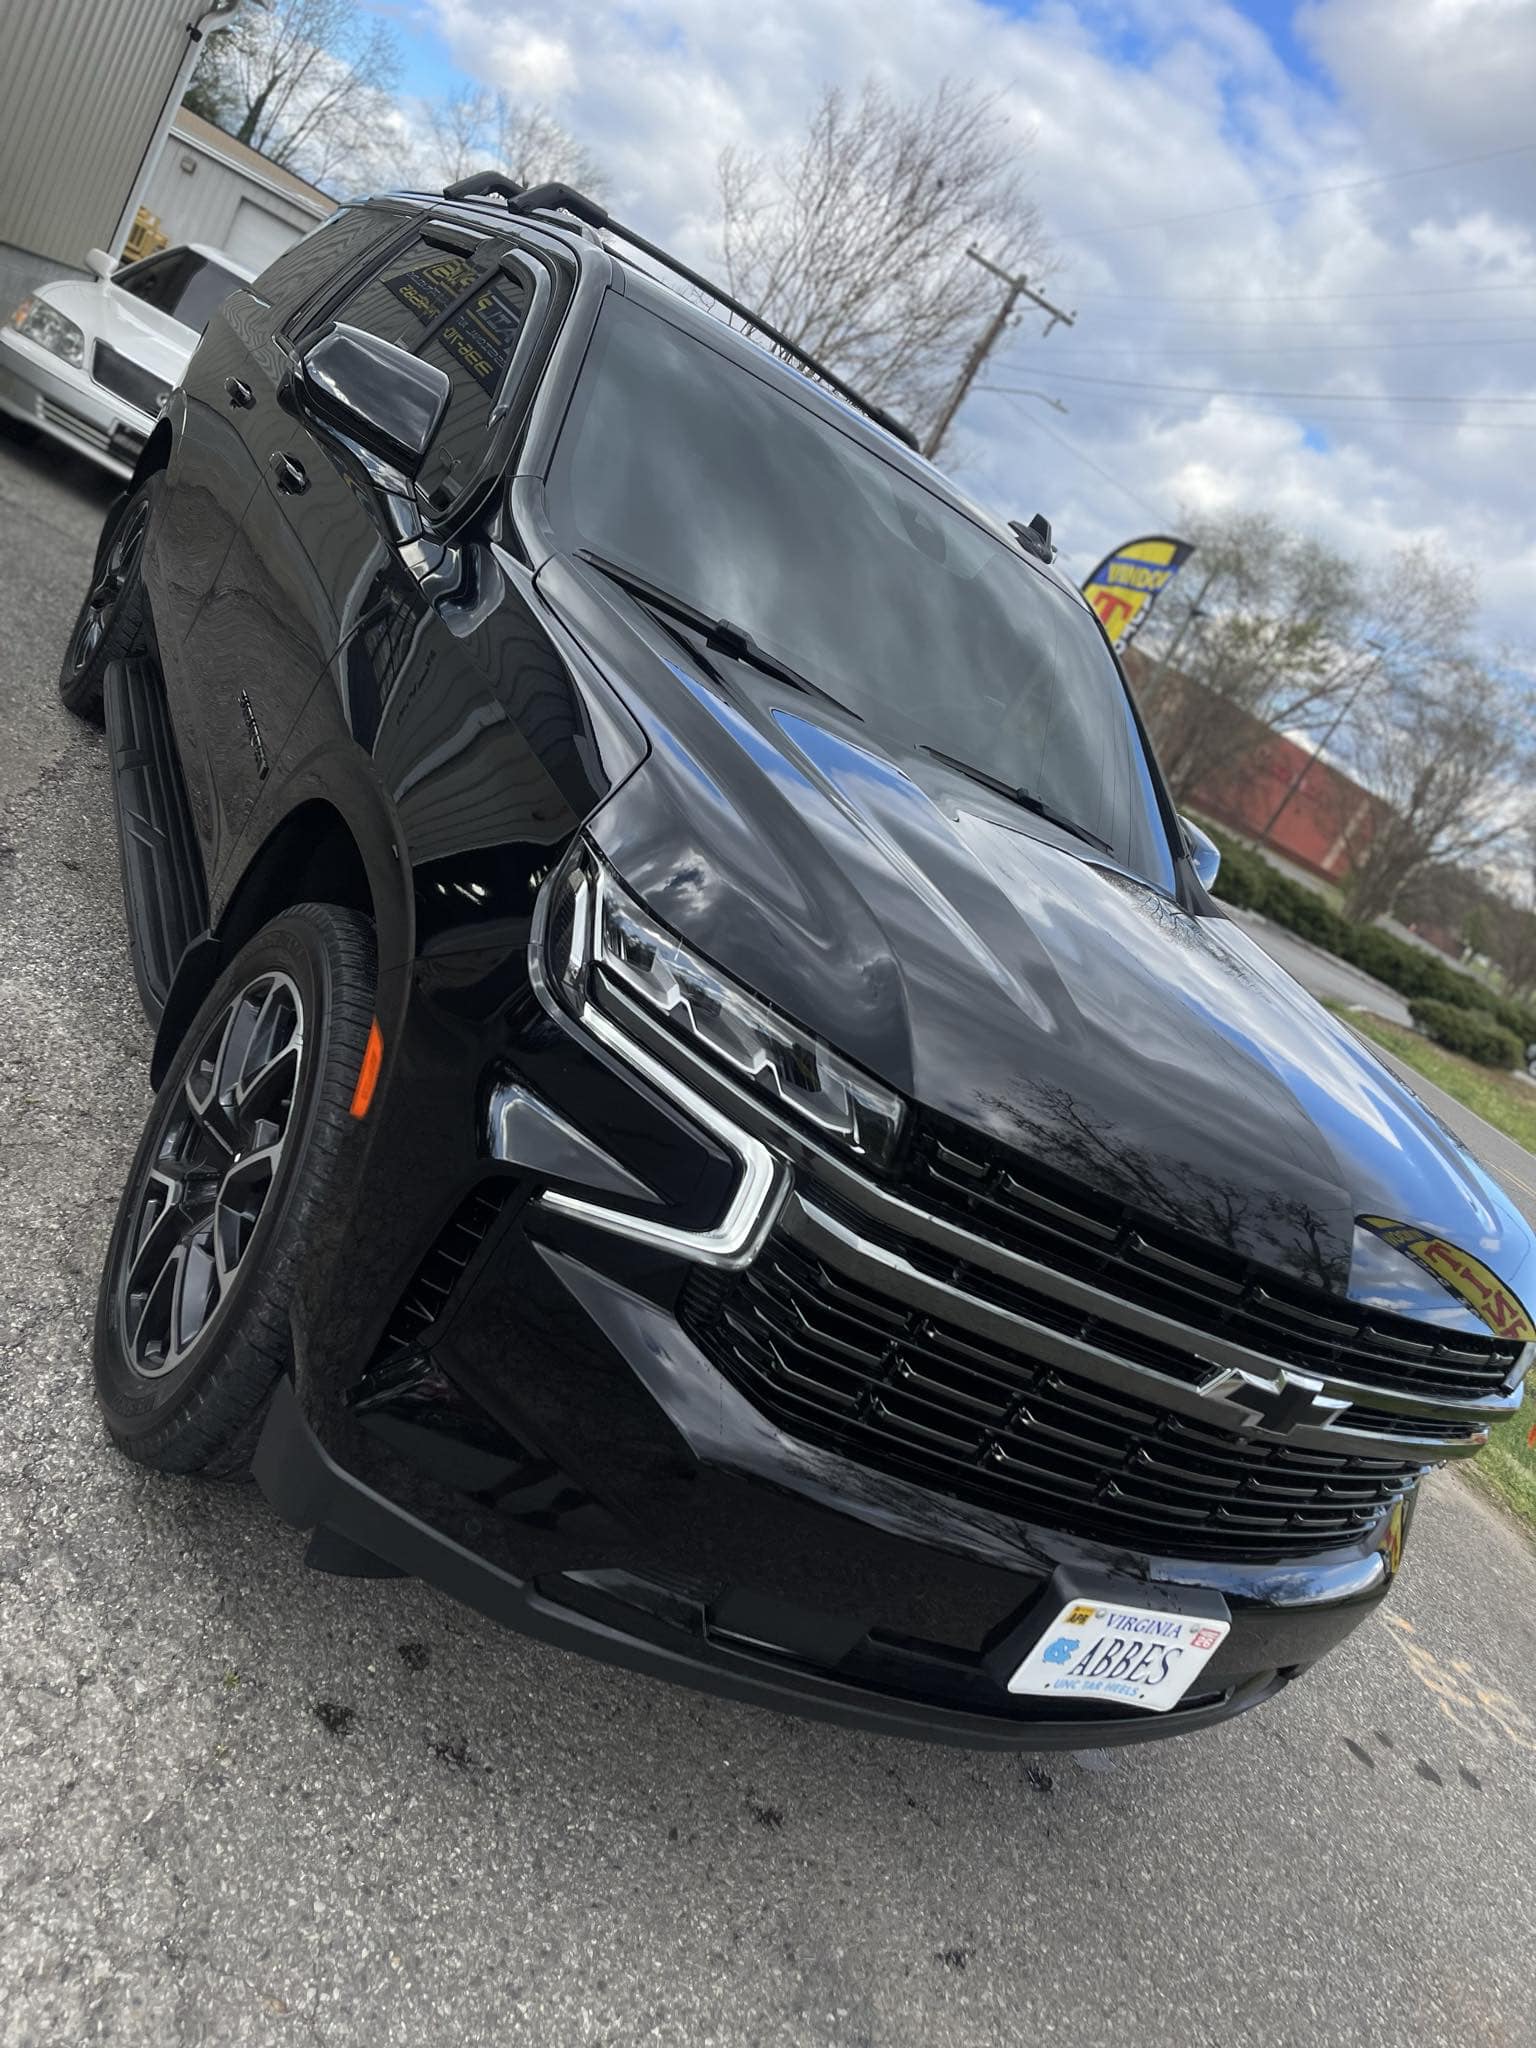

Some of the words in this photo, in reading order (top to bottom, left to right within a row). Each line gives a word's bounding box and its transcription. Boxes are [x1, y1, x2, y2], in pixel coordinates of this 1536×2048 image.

[1106, 1613, 1184, 1639] VIRGINIA
[1067, 1636, 1184, 1686] ABBES
[1104, 1683, 1139, 1697] HEELS
